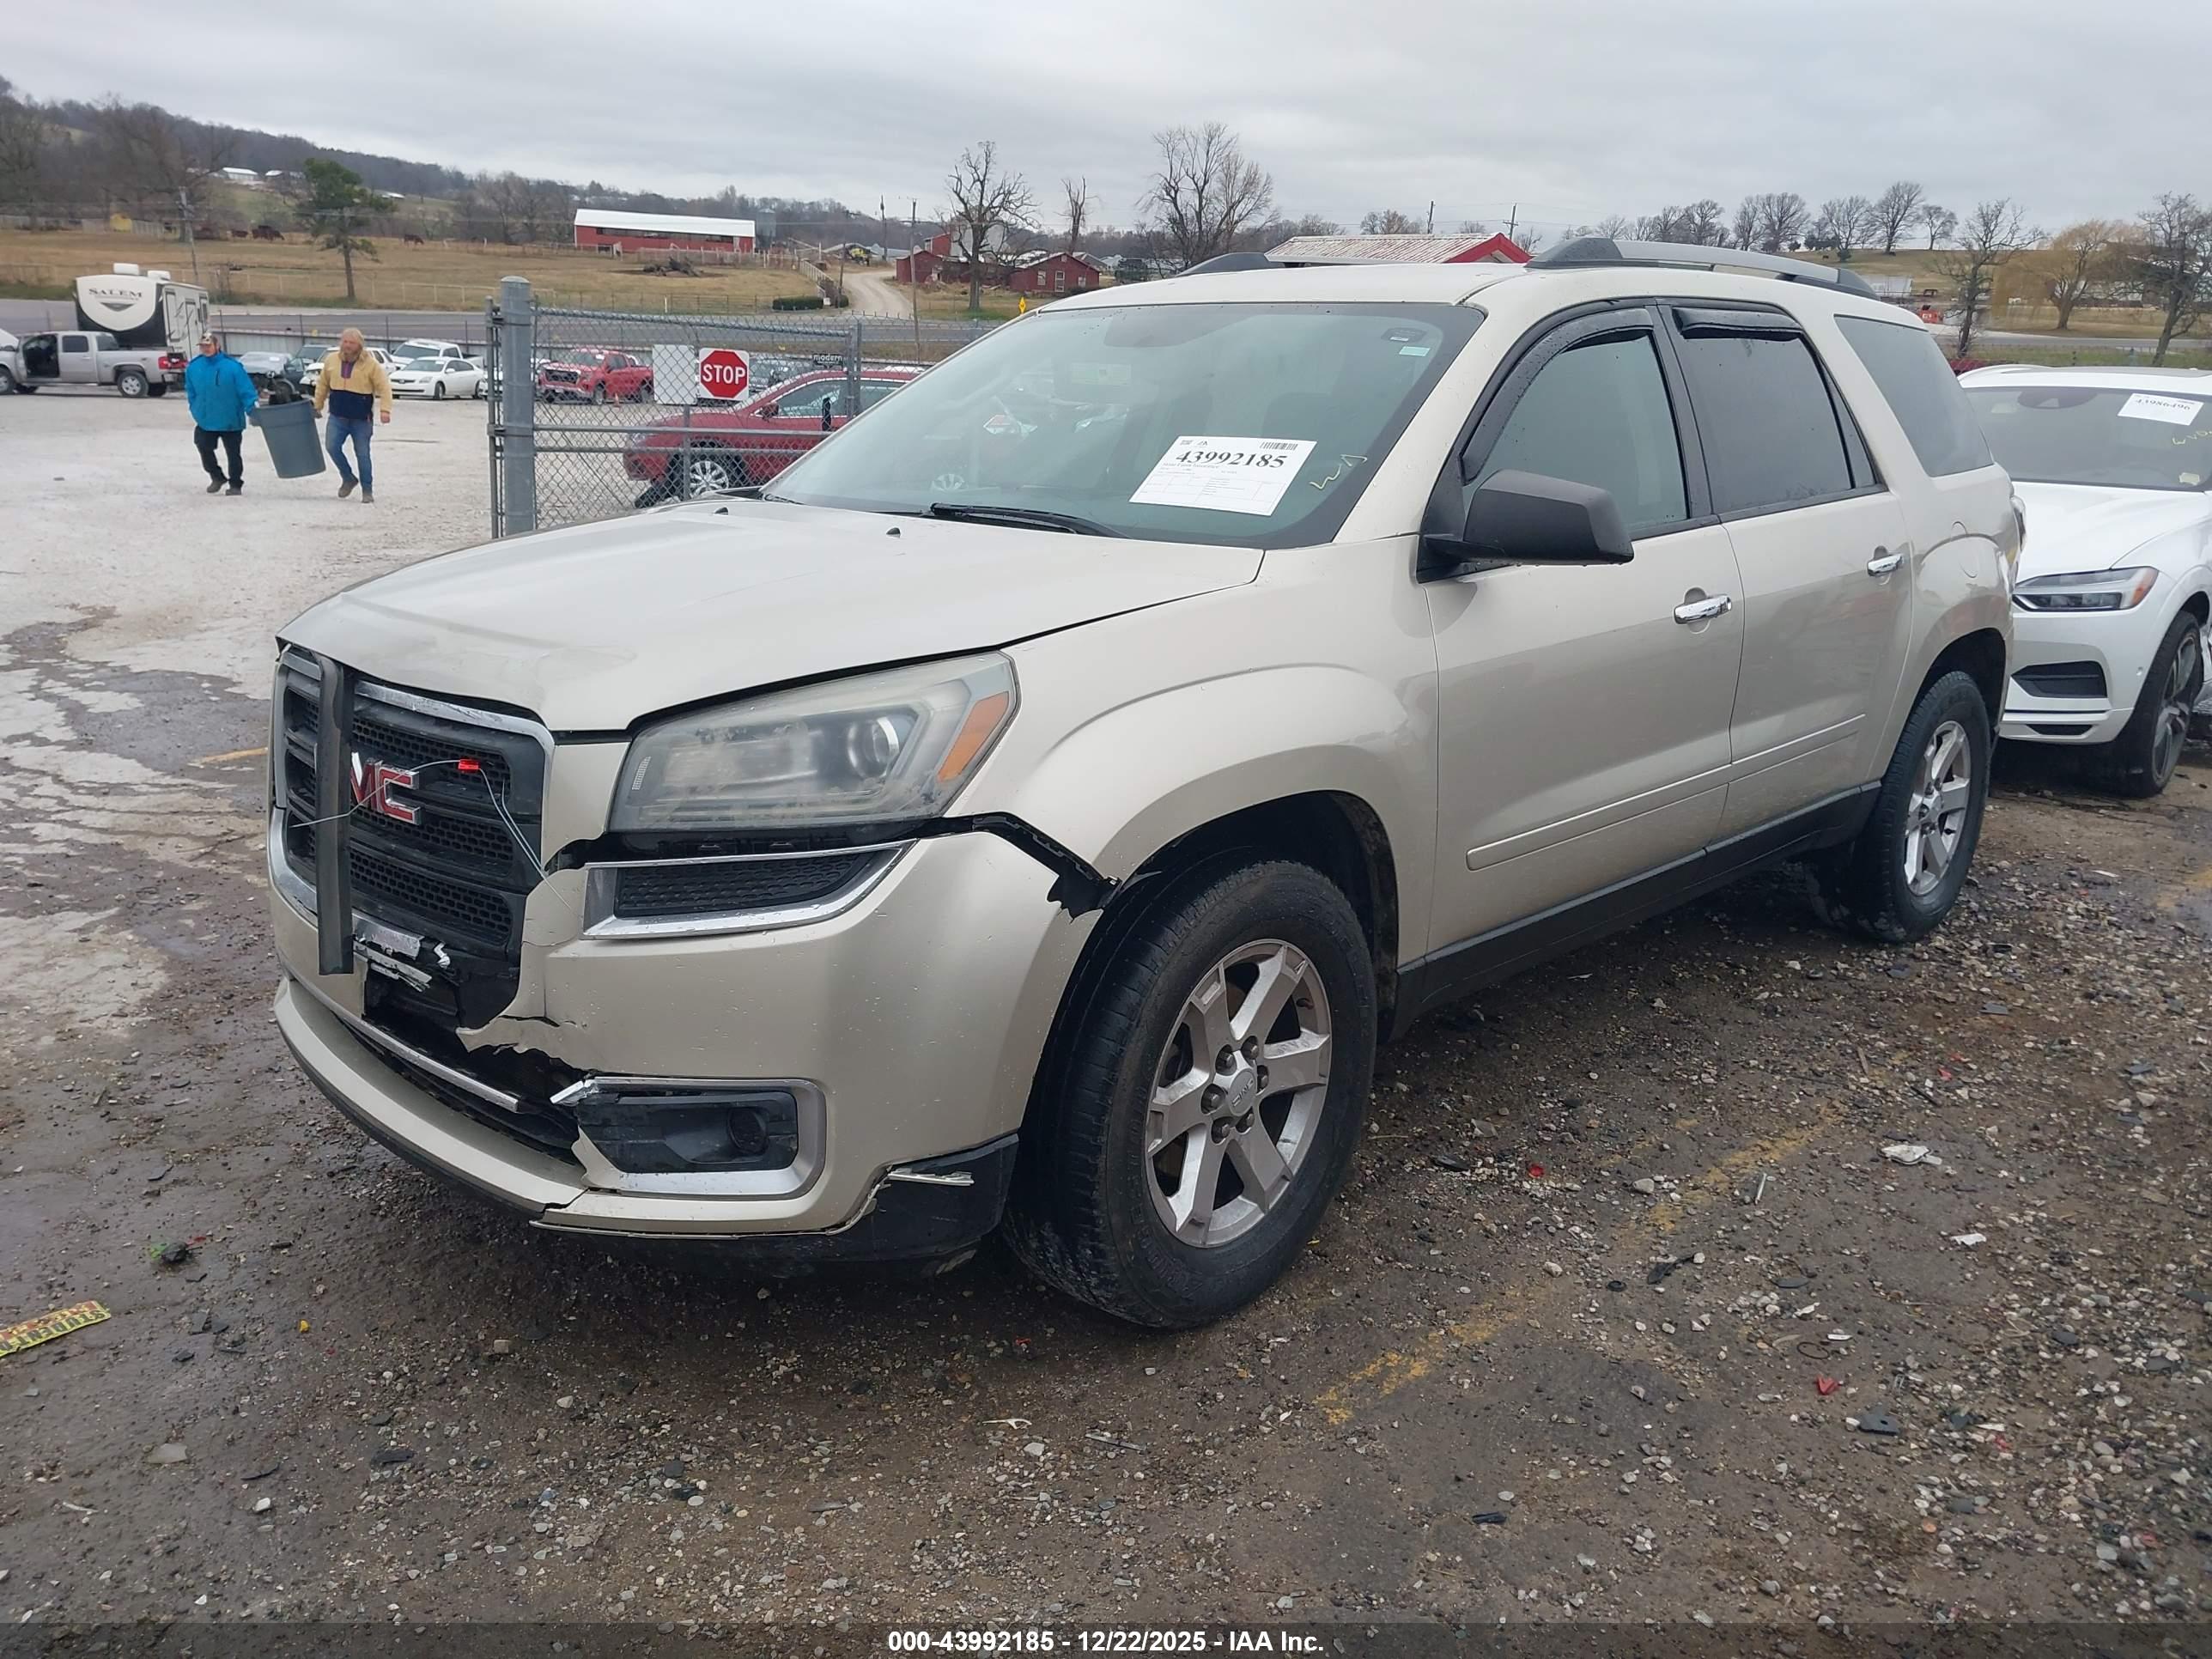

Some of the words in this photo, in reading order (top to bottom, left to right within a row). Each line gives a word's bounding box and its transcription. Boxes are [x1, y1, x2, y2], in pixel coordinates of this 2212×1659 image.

[88, 288, 143, 298] SALEM
[813, 353, 843, 362] modern
[702, 363, 746, 386] STOP
[1175, 450, 1288, 470] 43992185
[350, 750, 421, 825] MC
